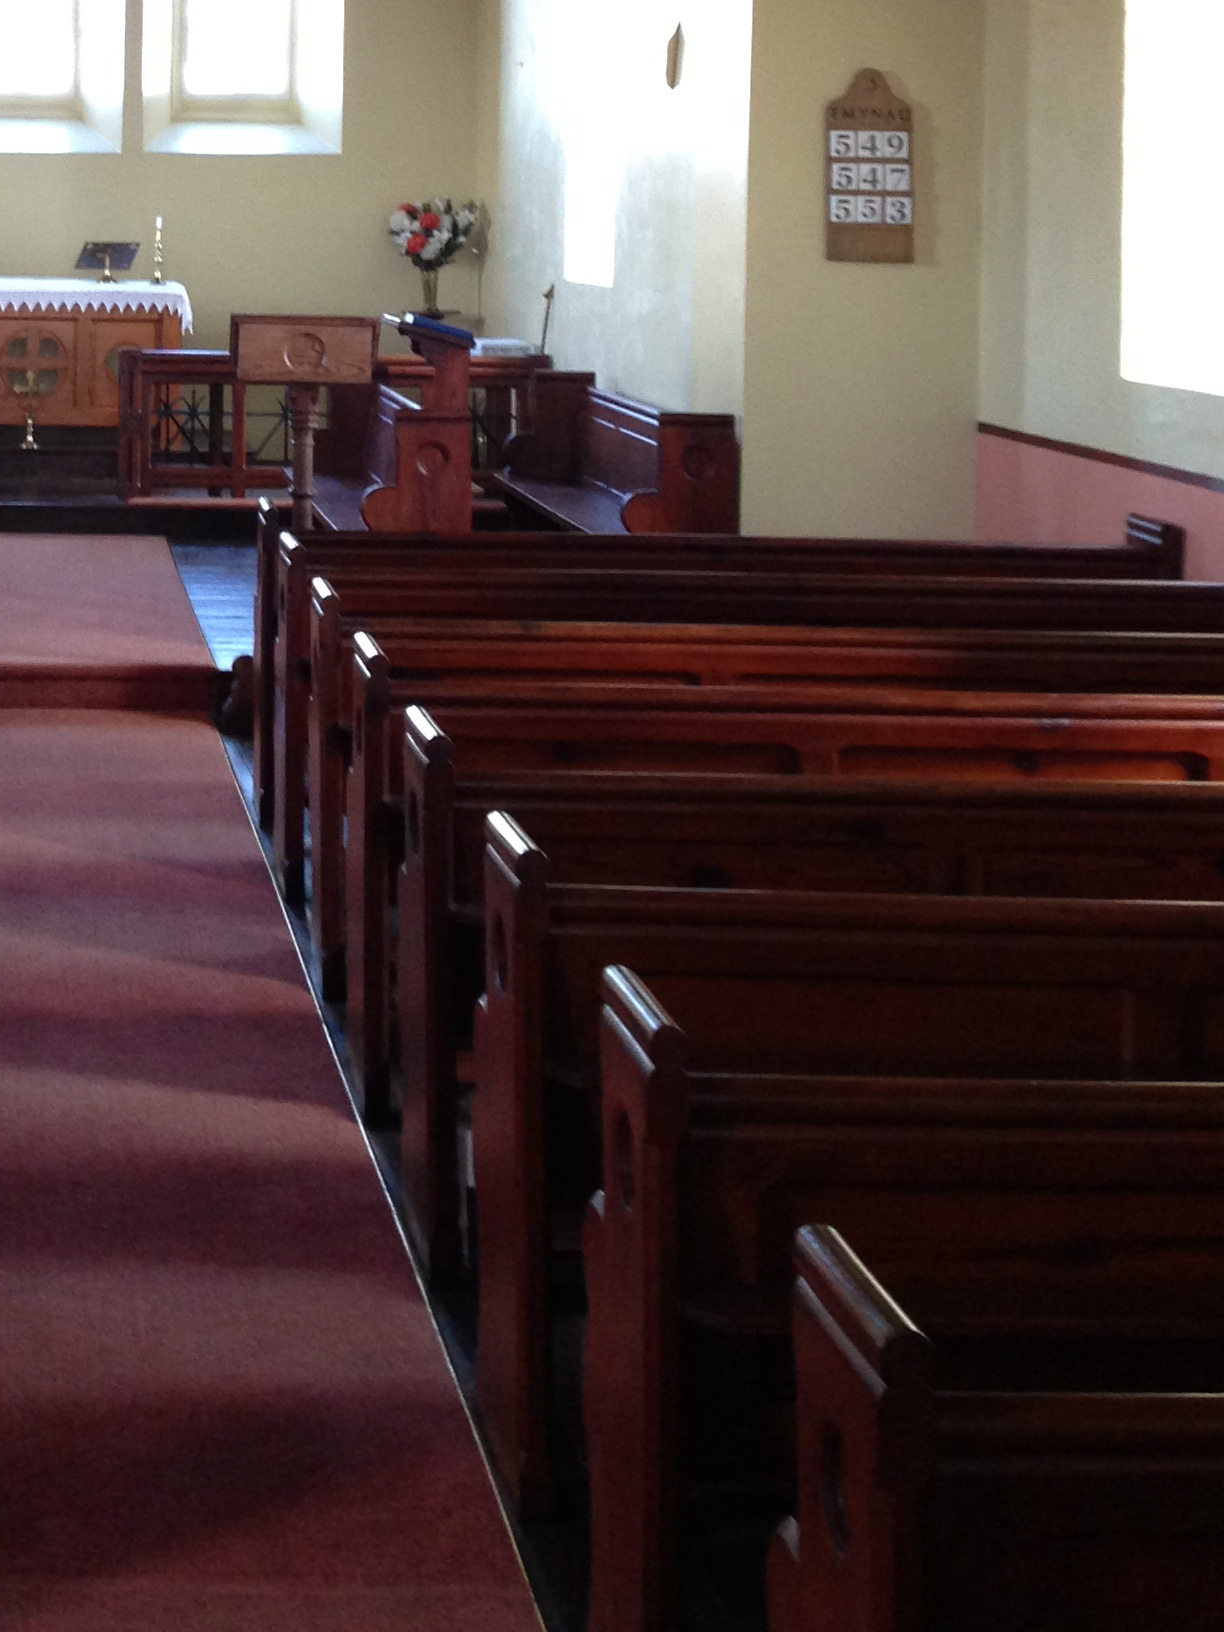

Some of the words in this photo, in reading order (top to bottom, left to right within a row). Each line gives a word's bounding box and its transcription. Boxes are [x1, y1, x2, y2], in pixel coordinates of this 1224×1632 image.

[834, 134, 904, 155] 549
[836, 167, 906, 188] 547
[834, 199, 907, 222] 553
